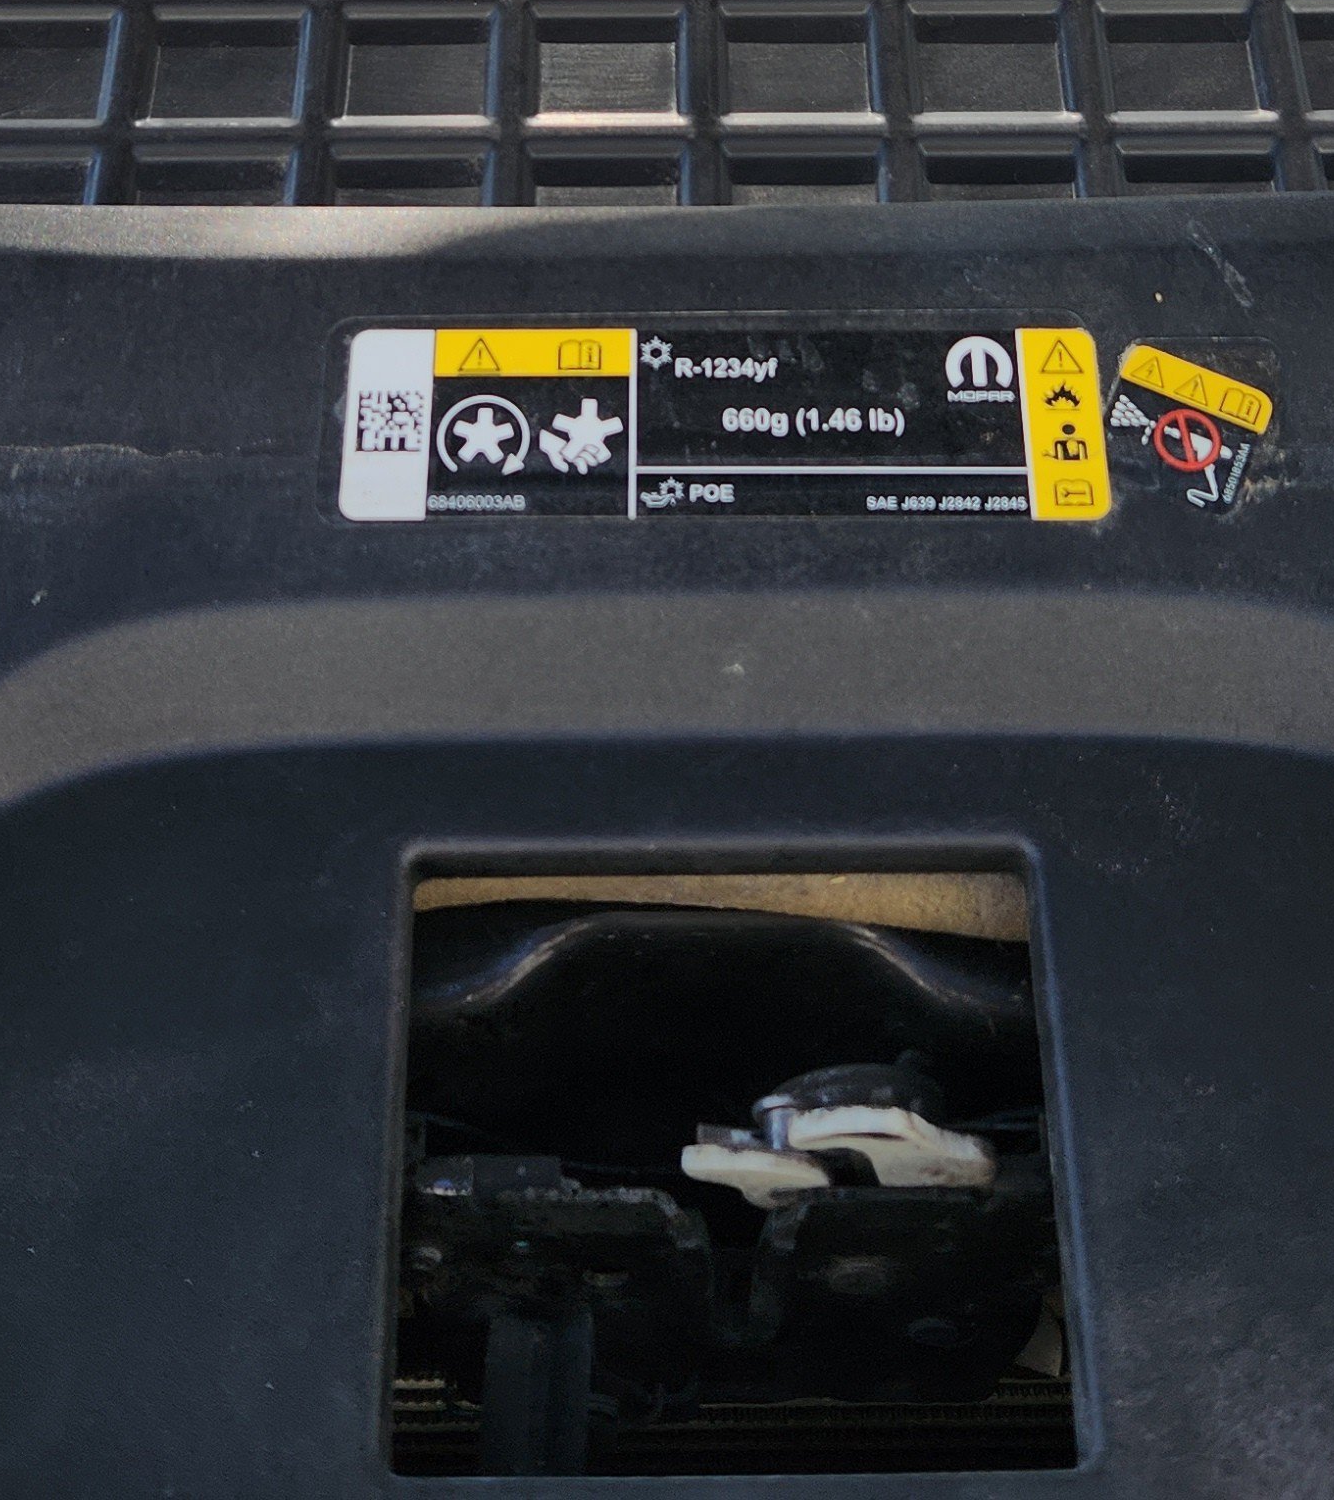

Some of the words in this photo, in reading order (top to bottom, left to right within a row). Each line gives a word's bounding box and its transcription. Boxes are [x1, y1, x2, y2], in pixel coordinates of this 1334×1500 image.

[674, 357, 779, 383] R-1234yf
[947, 389, 1016, 403] MOPAR
[721, 407, 789, 437] 660g
[795, 407, 863, 437] (1.46
[868, 407, 905, 437] lb)
[689, 483, 736, 503] POE
[866, 495, 899, 511] SAE
[900, 495, 937, 511] J639
[938, 495, 982, 511] J2842
[984, 495, 1029, 511] J2845
